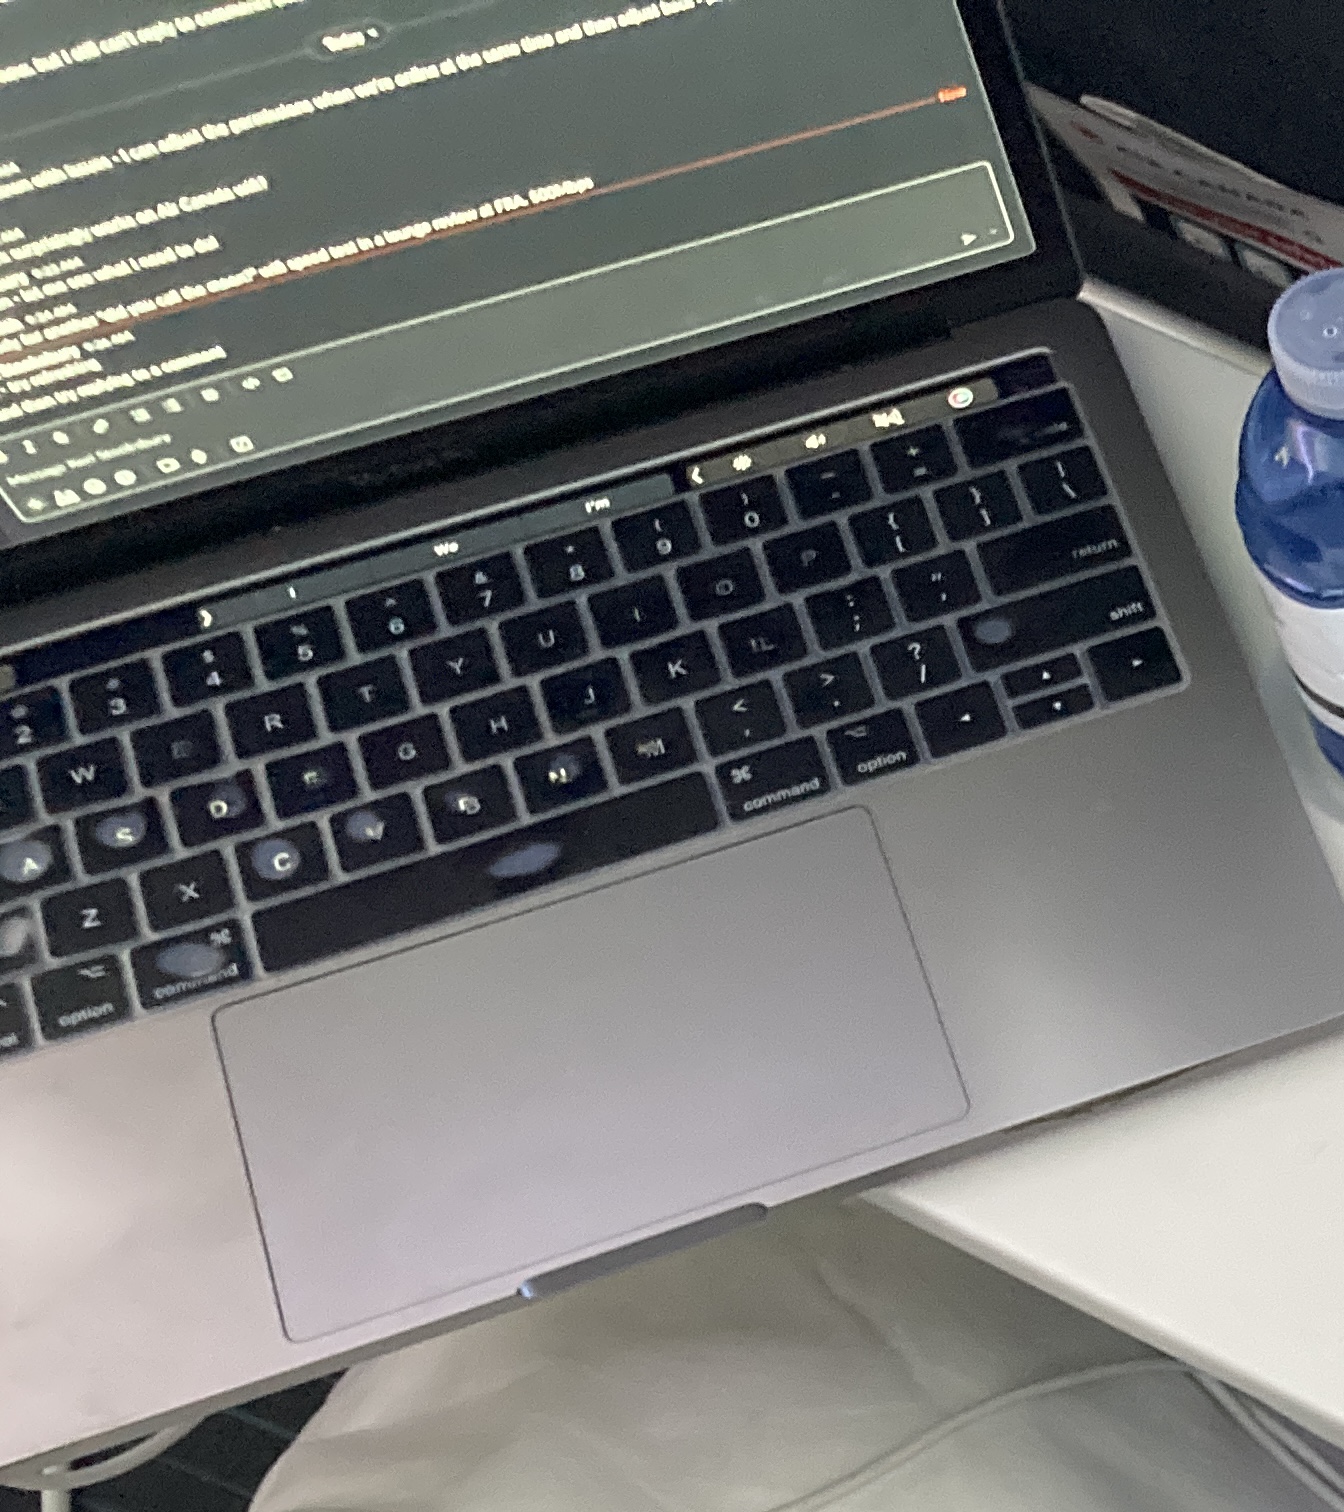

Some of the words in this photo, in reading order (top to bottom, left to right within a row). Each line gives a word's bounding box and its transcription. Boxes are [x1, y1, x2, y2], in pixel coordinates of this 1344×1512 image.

[537, 629, 556, 648] U
[667, 659, 688, 680] K
[264, 713, 284, 732] R
[489, 715, 509, 735] H
[857, 748, 907, 774] option
[69, 765, 97, 786] W
[743, 776, 821, 813] command
[114, 826, 134, 845] S
[58, 1001, 115, 1028] option
